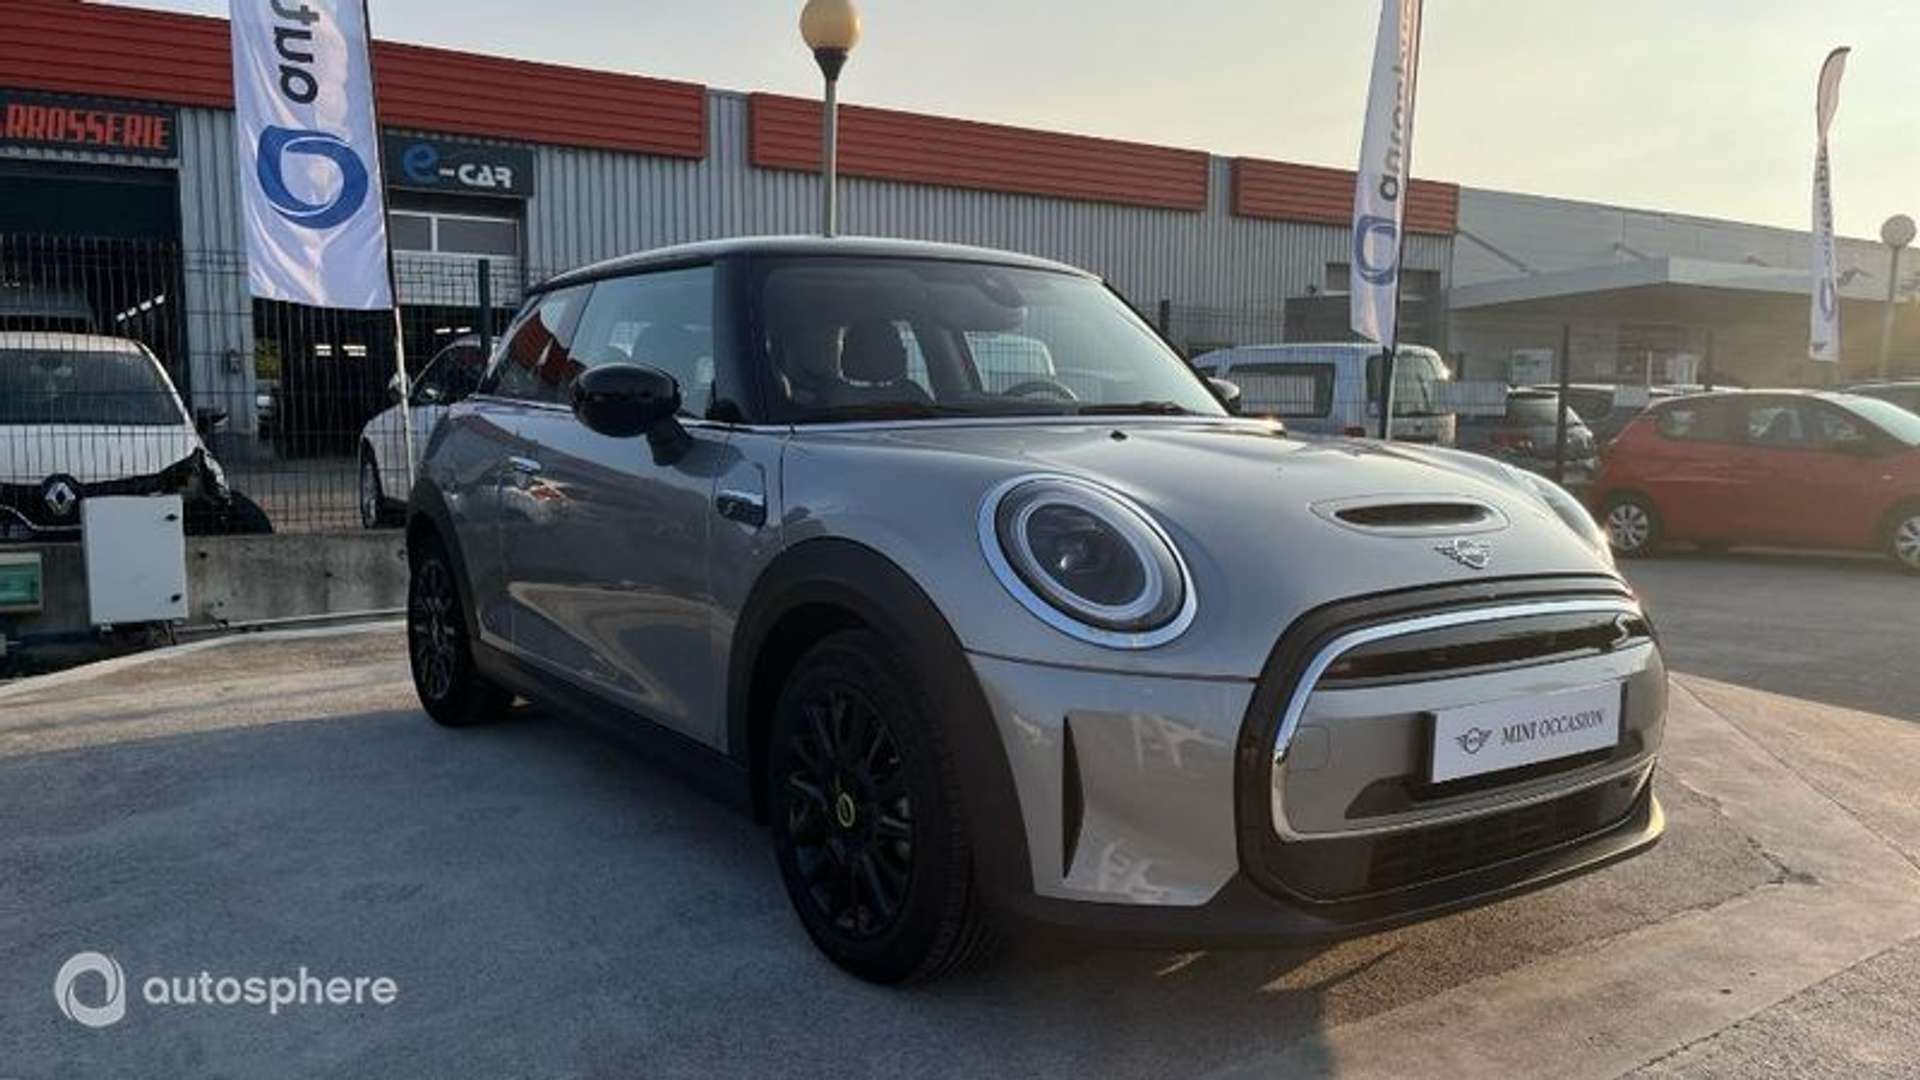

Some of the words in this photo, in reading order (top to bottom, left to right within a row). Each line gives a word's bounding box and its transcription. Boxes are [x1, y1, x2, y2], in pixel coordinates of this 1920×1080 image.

[0, 104, 170, 149] RROSSERIE
[1502, 721, 1537, 746] MINI
[1538, 708, 1605, 739] OCCASION
